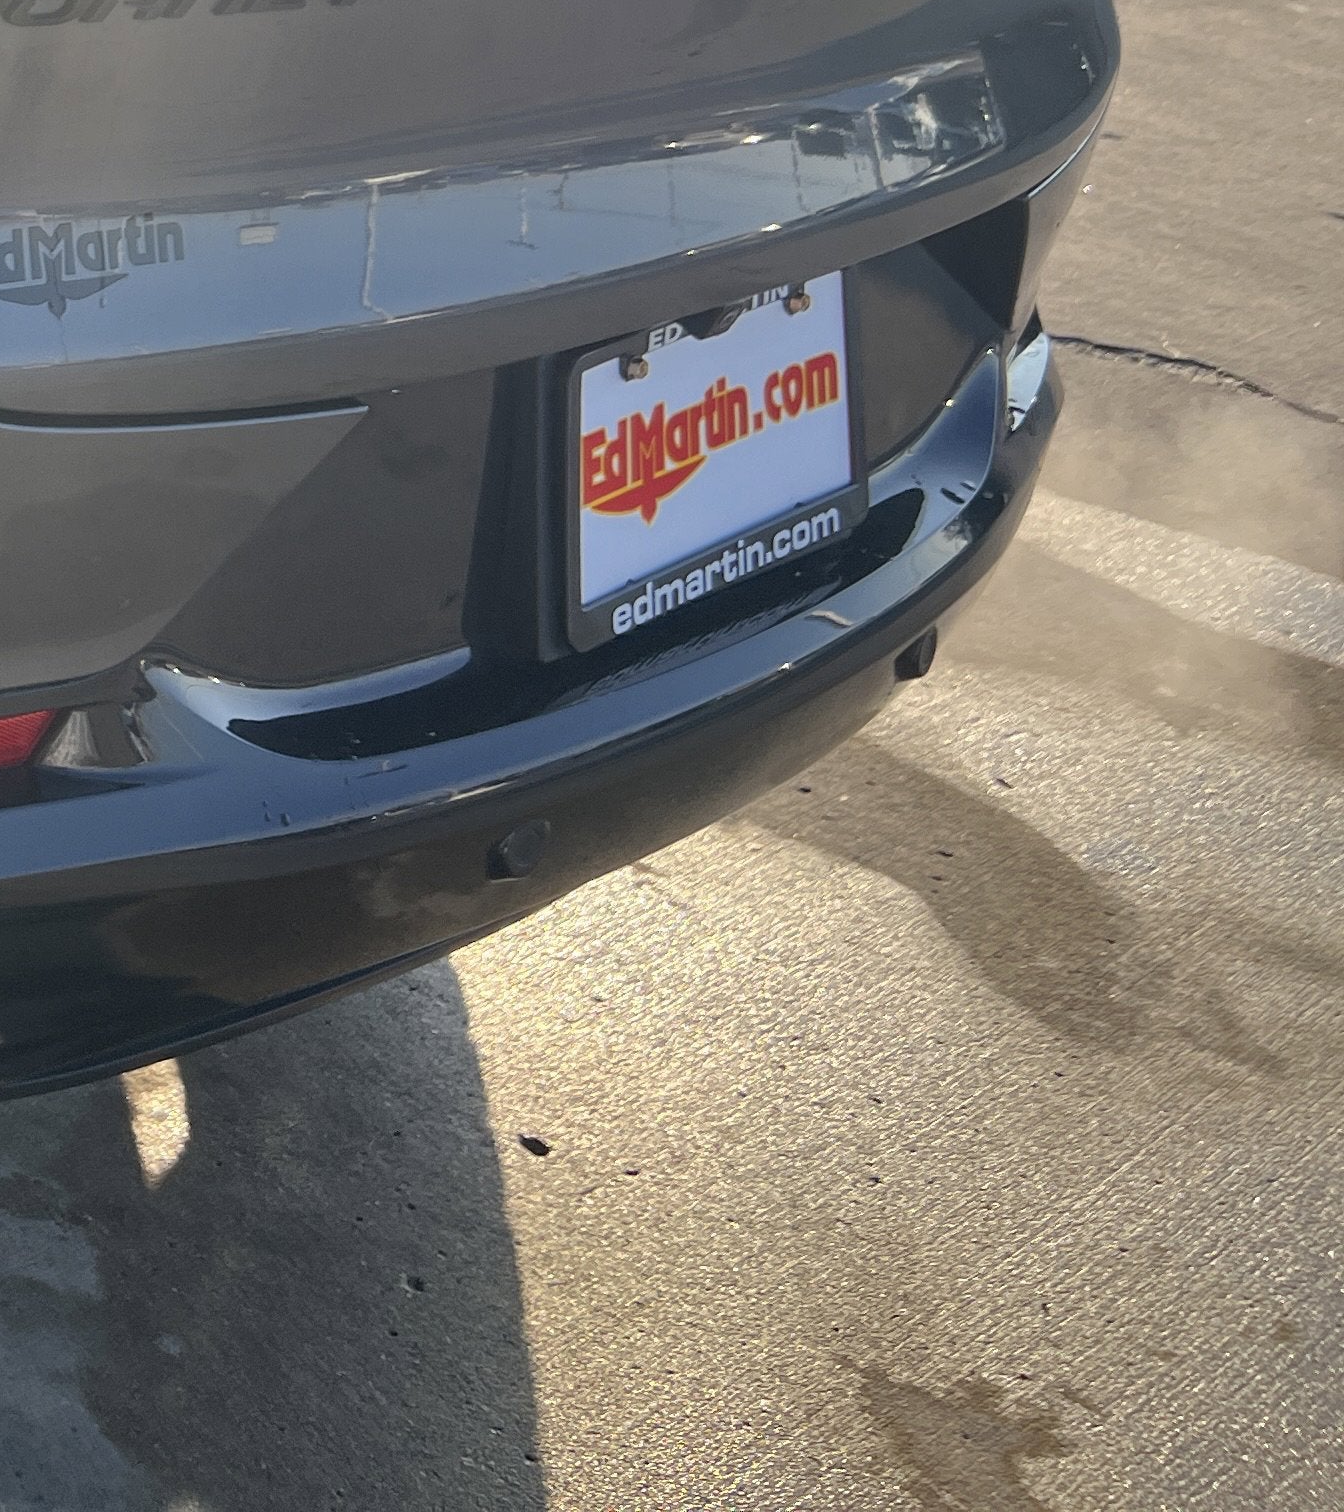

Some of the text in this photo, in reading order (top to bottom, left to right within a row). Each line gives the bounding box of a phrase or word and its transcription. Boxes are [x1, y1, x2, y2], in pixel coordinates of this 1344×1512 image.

[648, 322, 684, 352] ED
[582, 351, 839, 507] EdMartin.com
[612, 505, 840, 636] edmartin.com
